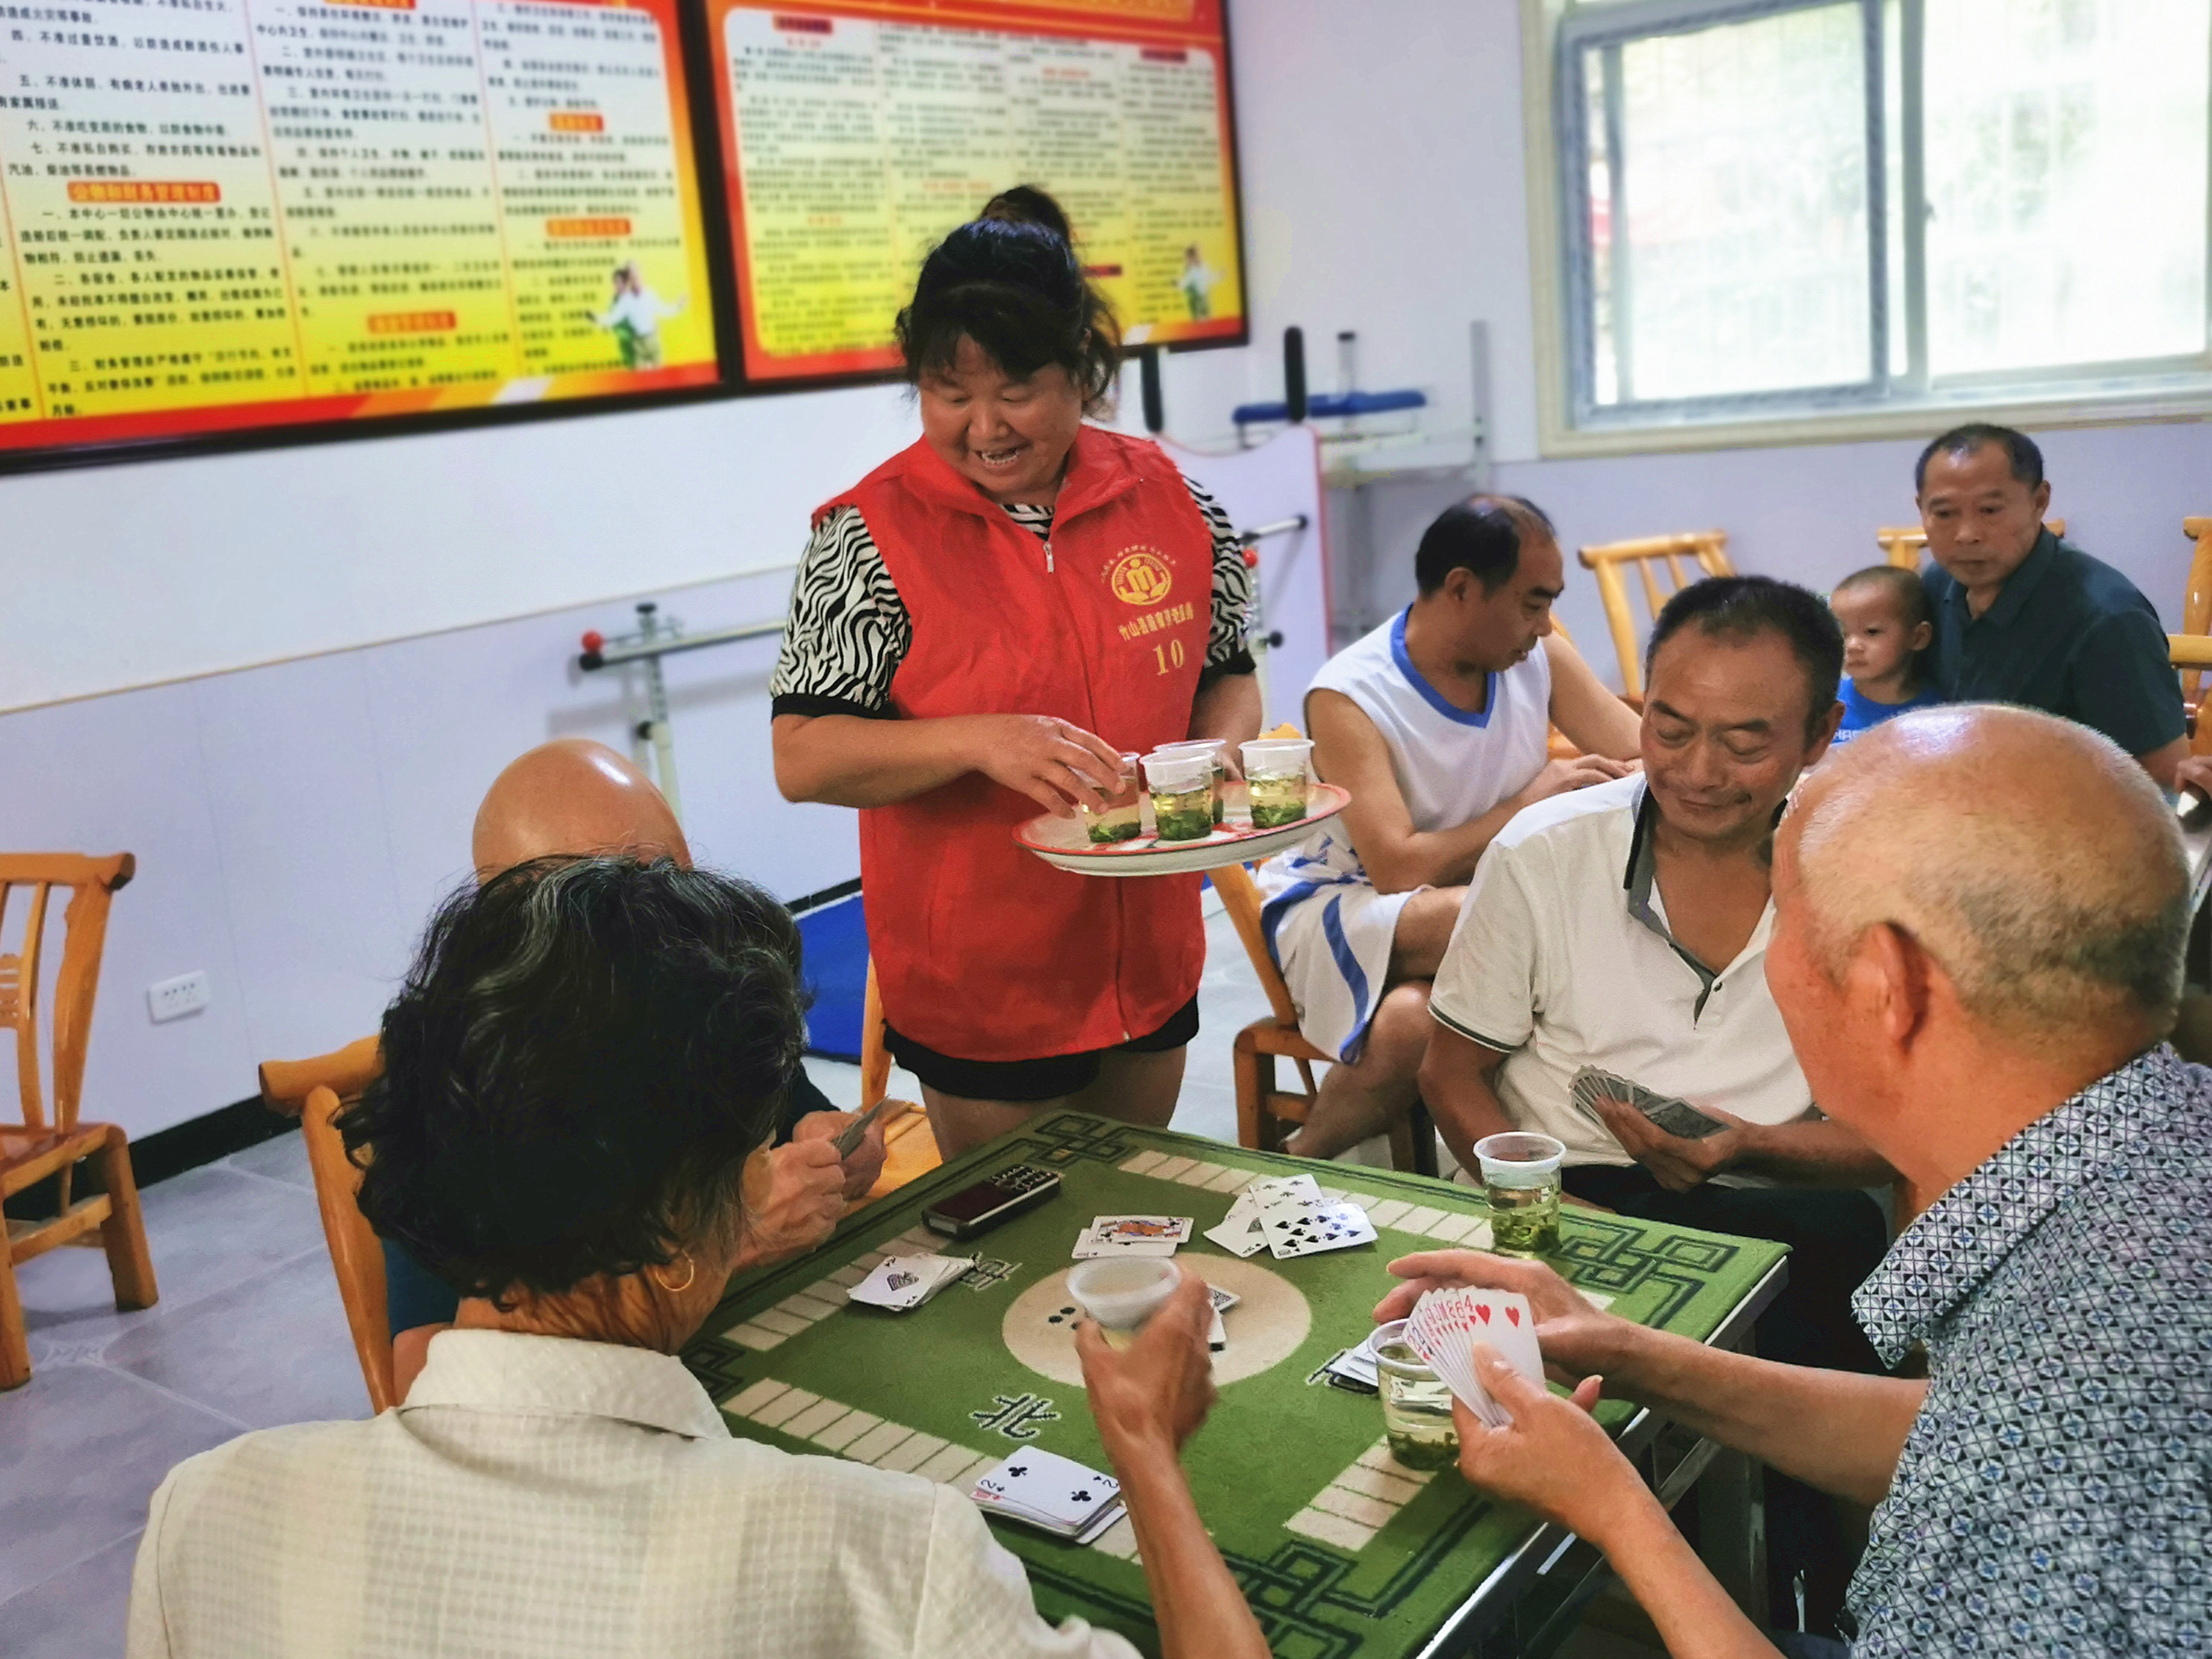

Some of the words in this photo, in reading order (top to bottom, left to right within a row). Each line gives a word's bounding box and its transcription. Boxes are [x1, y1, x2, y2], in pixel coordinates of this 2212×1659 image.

[1153, 638, 1184, 676] 10
[1464, 1295, 1474, 1313] 4
[970, 1393, 1061, 1440] 北
